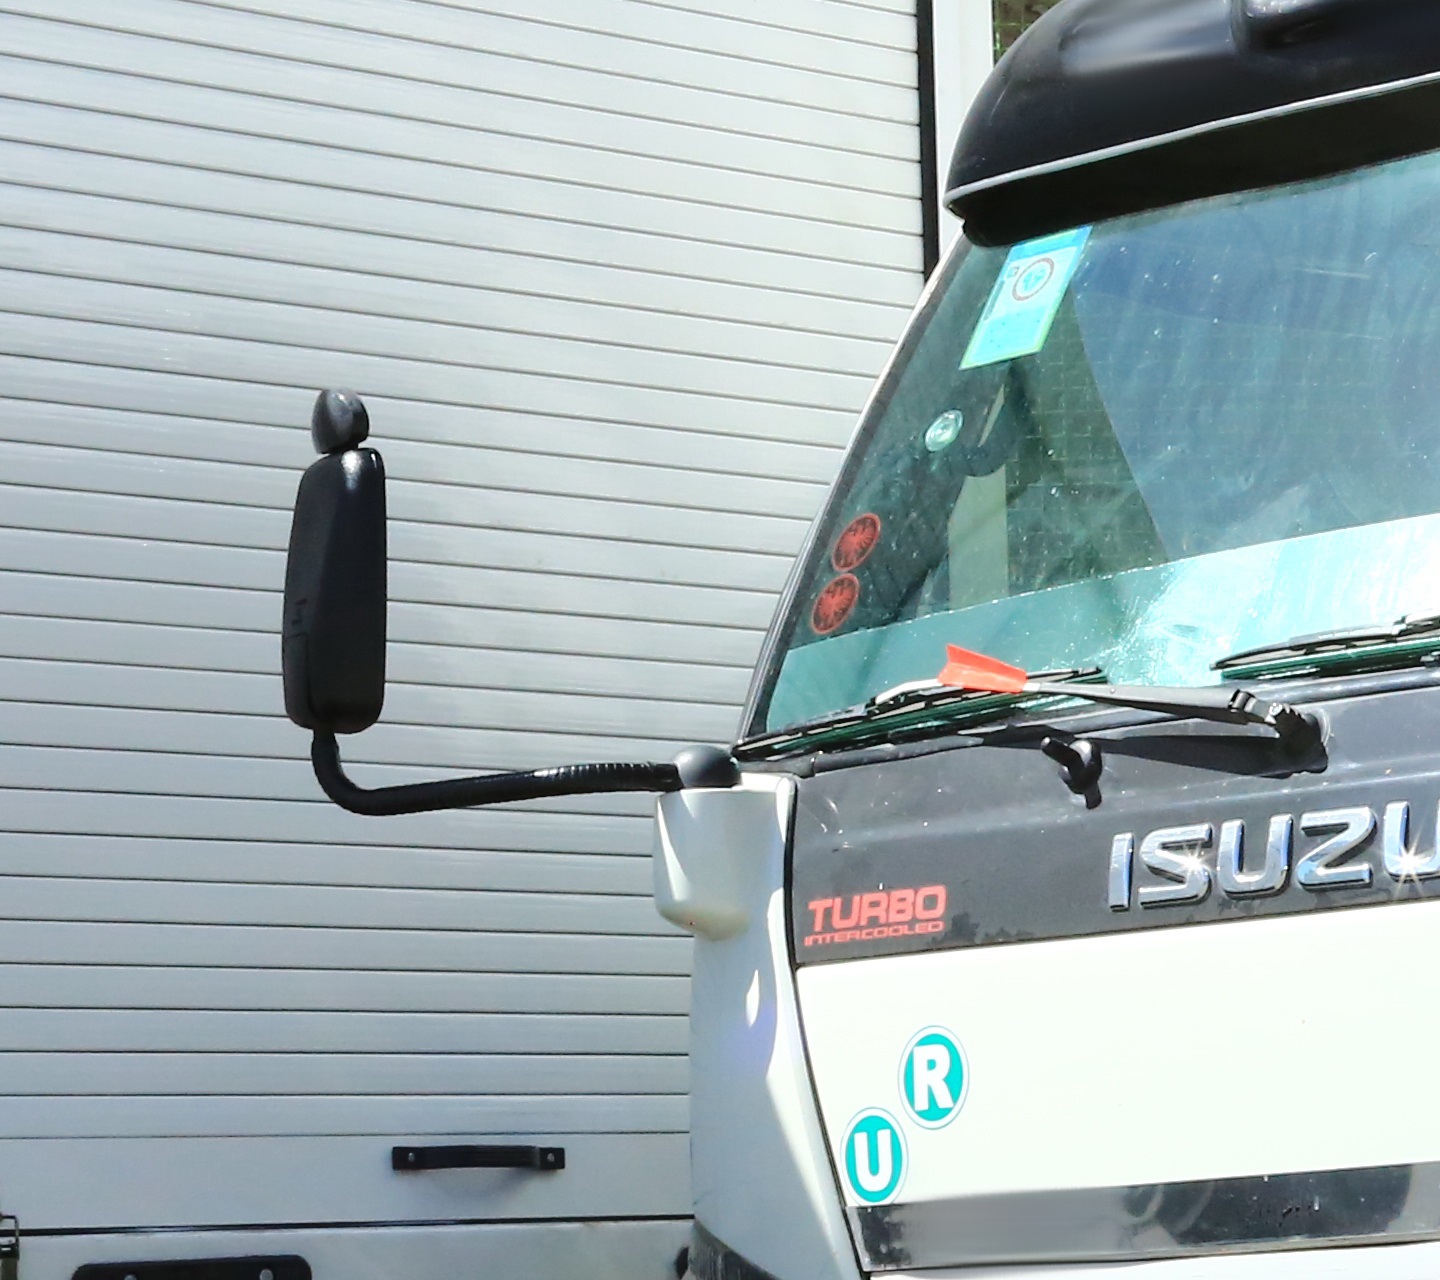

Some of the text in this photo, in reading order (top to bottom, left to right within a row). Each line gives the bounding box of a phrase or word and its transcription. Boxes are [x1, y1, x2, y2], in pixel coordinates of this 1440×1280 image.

[804, 921, 945, 947] INTERCOOLED
[807, 884, 947, 933] TURBO
[912, 1044, 953, 1111] R
[854, 1127, 894, 1191] U
